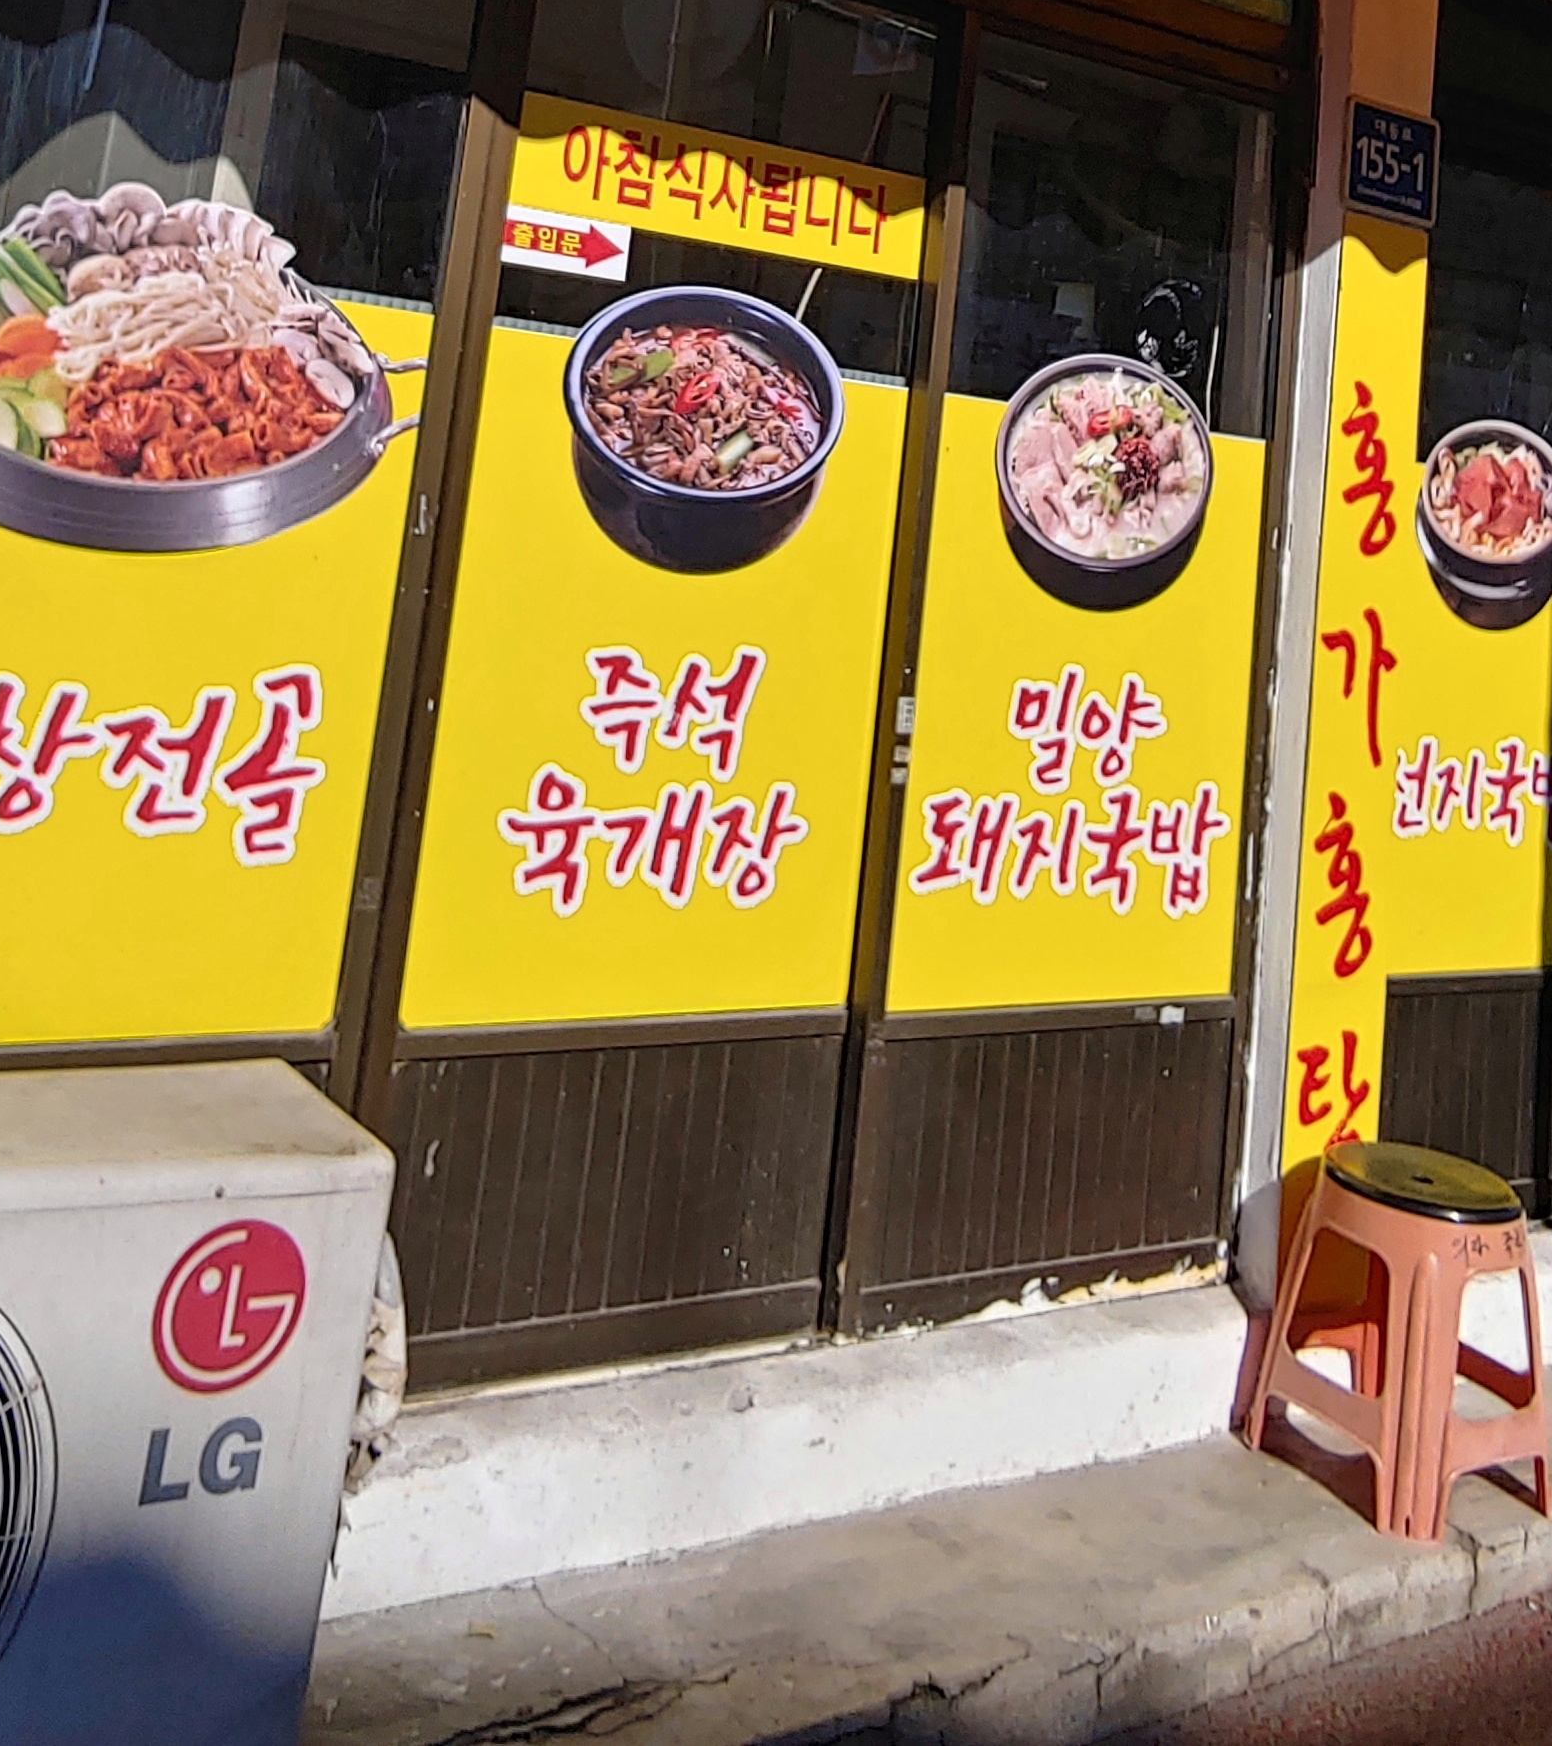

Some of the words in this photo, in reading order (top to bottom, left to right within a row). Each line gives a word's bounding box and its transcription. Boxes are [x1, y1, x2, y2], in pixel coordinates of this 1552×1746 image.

[562, 123, 890, 255] 아침식사됩니다
[1356, 136, 1424, 193] 155-1
[510, 221, 583, 258] 출입문
[581, 645, 766, 781] 즉석
[1009, 665, 1167, 794] 밀양
[498, 763, 808, 915] 육개장
[910, 782, 1230, 918] 돼지국밥
[138, 1415, 262, 1507] LG
